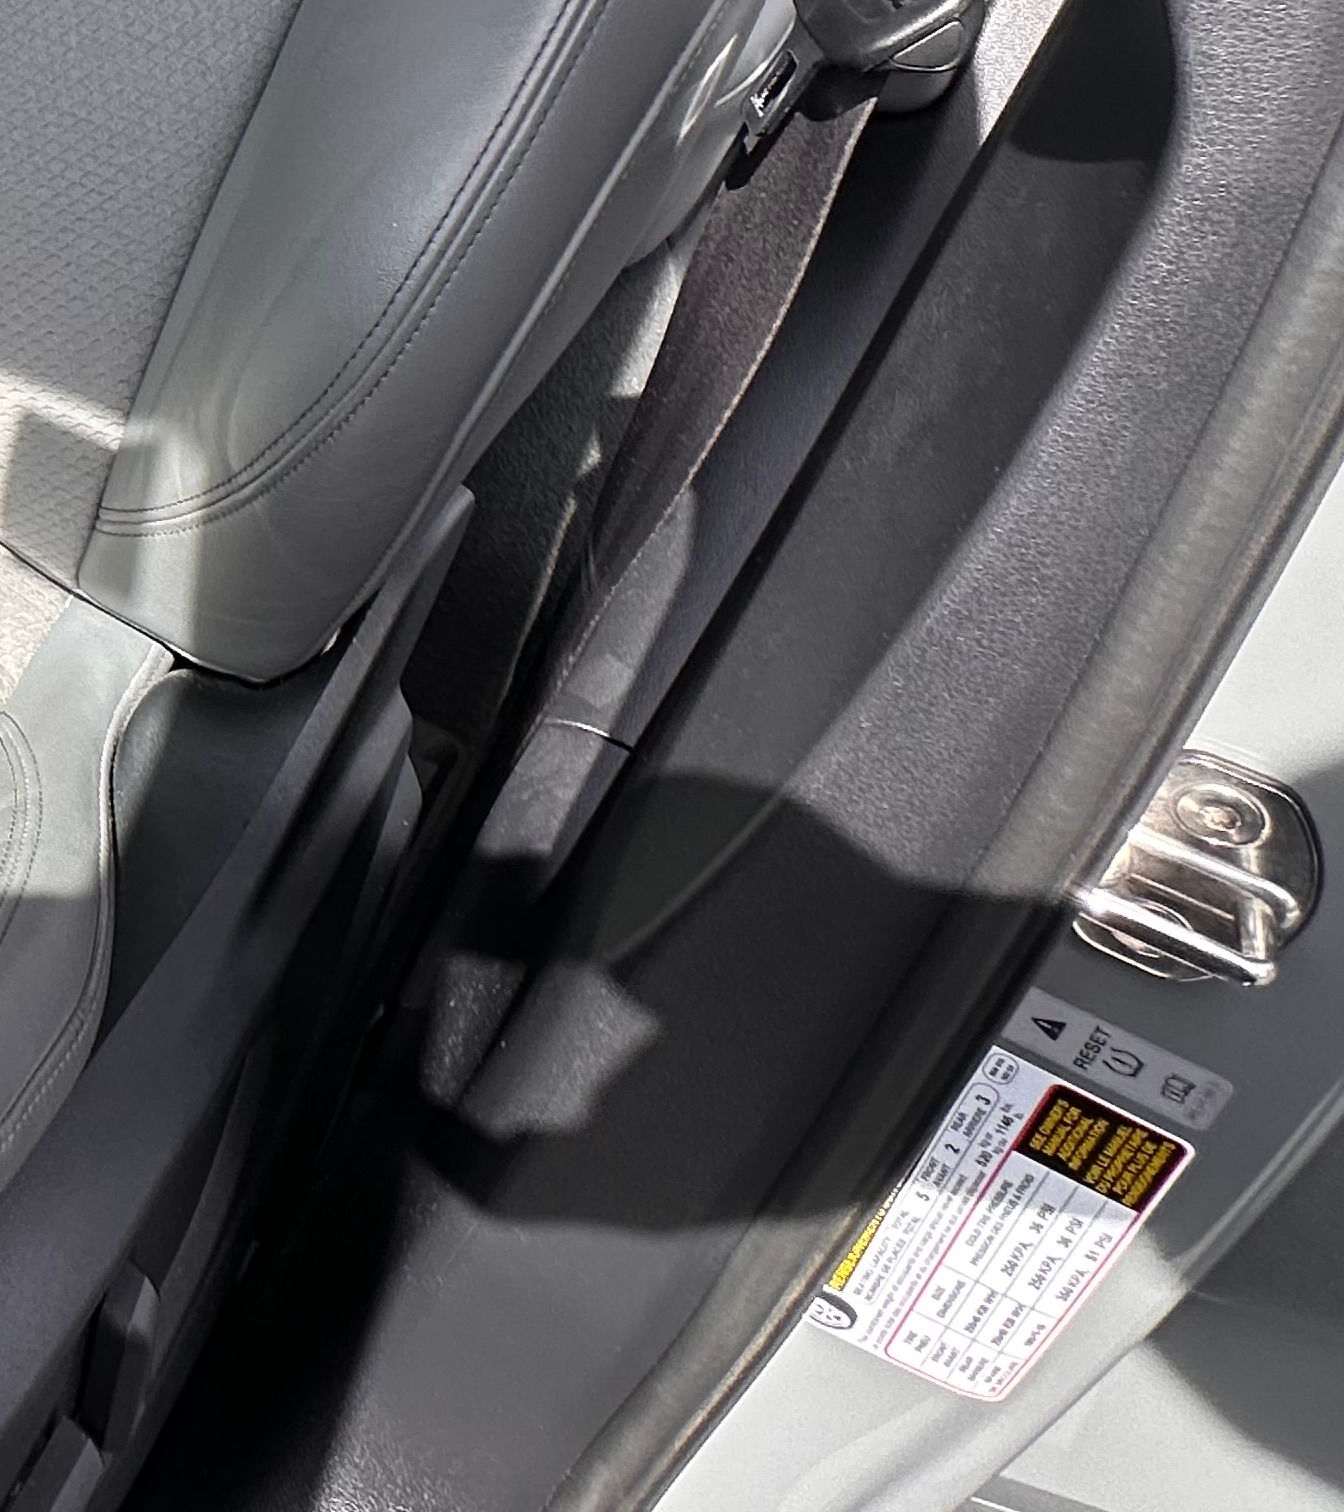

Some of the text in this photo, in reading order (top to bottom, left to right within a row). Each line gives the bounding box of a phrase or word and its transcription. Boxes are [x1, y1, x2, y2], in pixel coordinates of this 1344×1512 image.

[1073, 1025, 1111, 1070] RESET
[974, 1093, 991, 1106] 3
[943, 1142, 960, 1154] 2
[915, 1190, 930, 1201] 5
